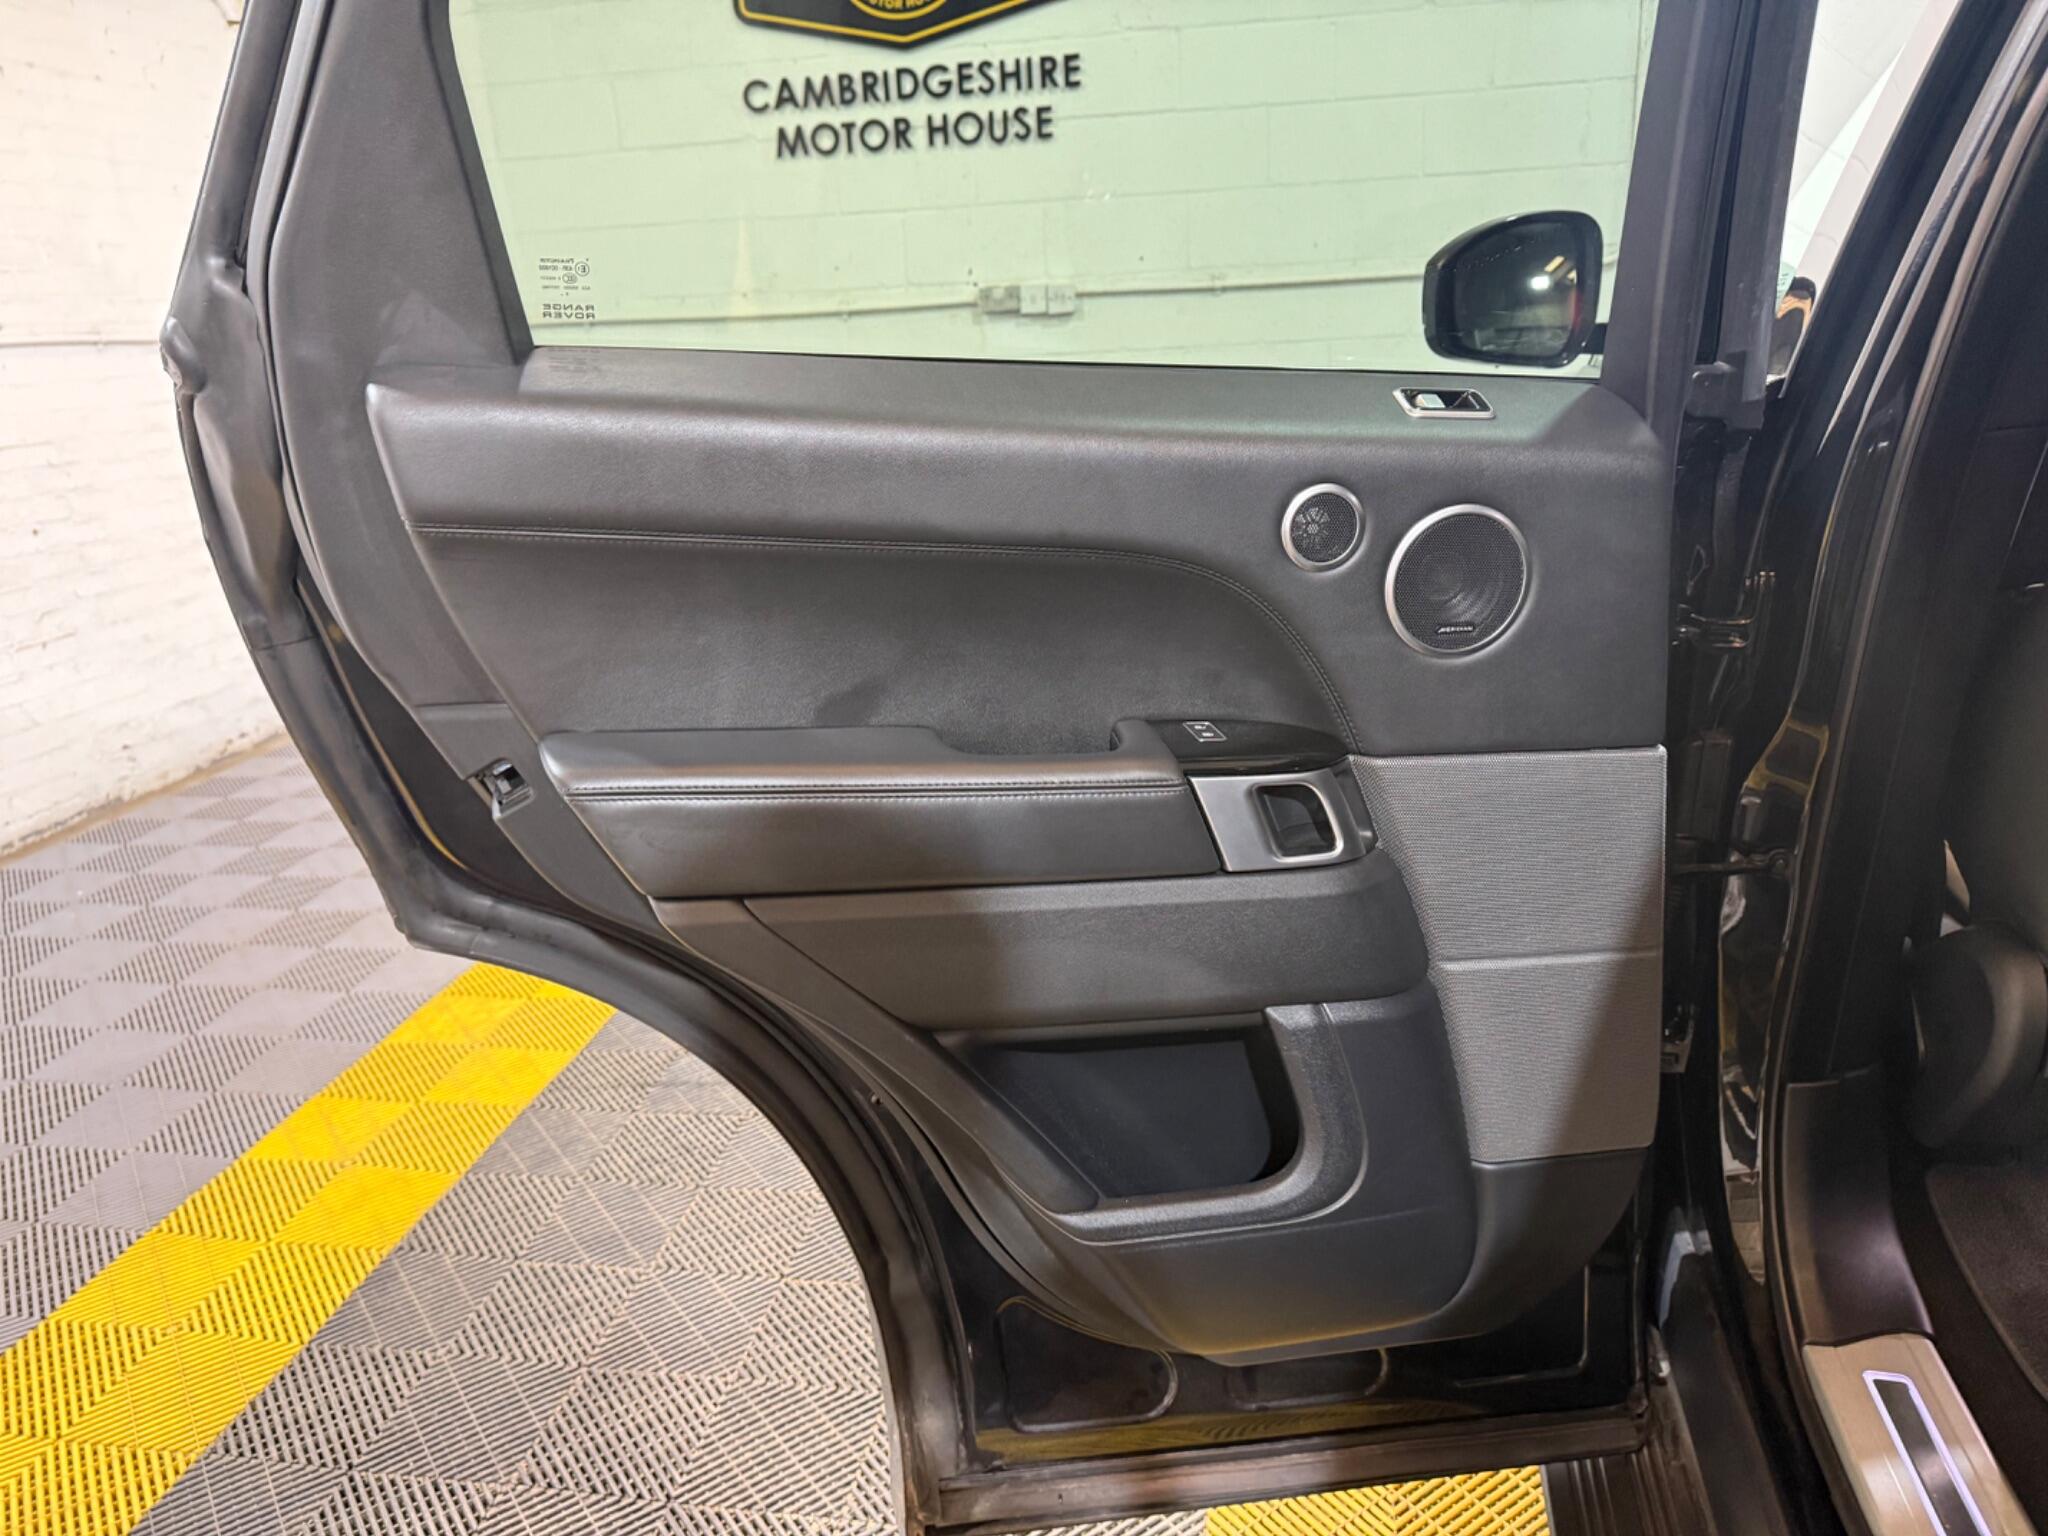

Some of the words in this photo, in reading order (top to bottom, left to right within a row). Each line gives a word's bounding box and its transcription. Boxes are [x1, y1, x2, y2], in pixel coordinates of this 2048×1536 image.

[743, 54, 1081, 114] CAMBRIDGESHIRE
[776, 118, 912, 159] MOTOR
[927, 106, 1053, 147] HOUSE
